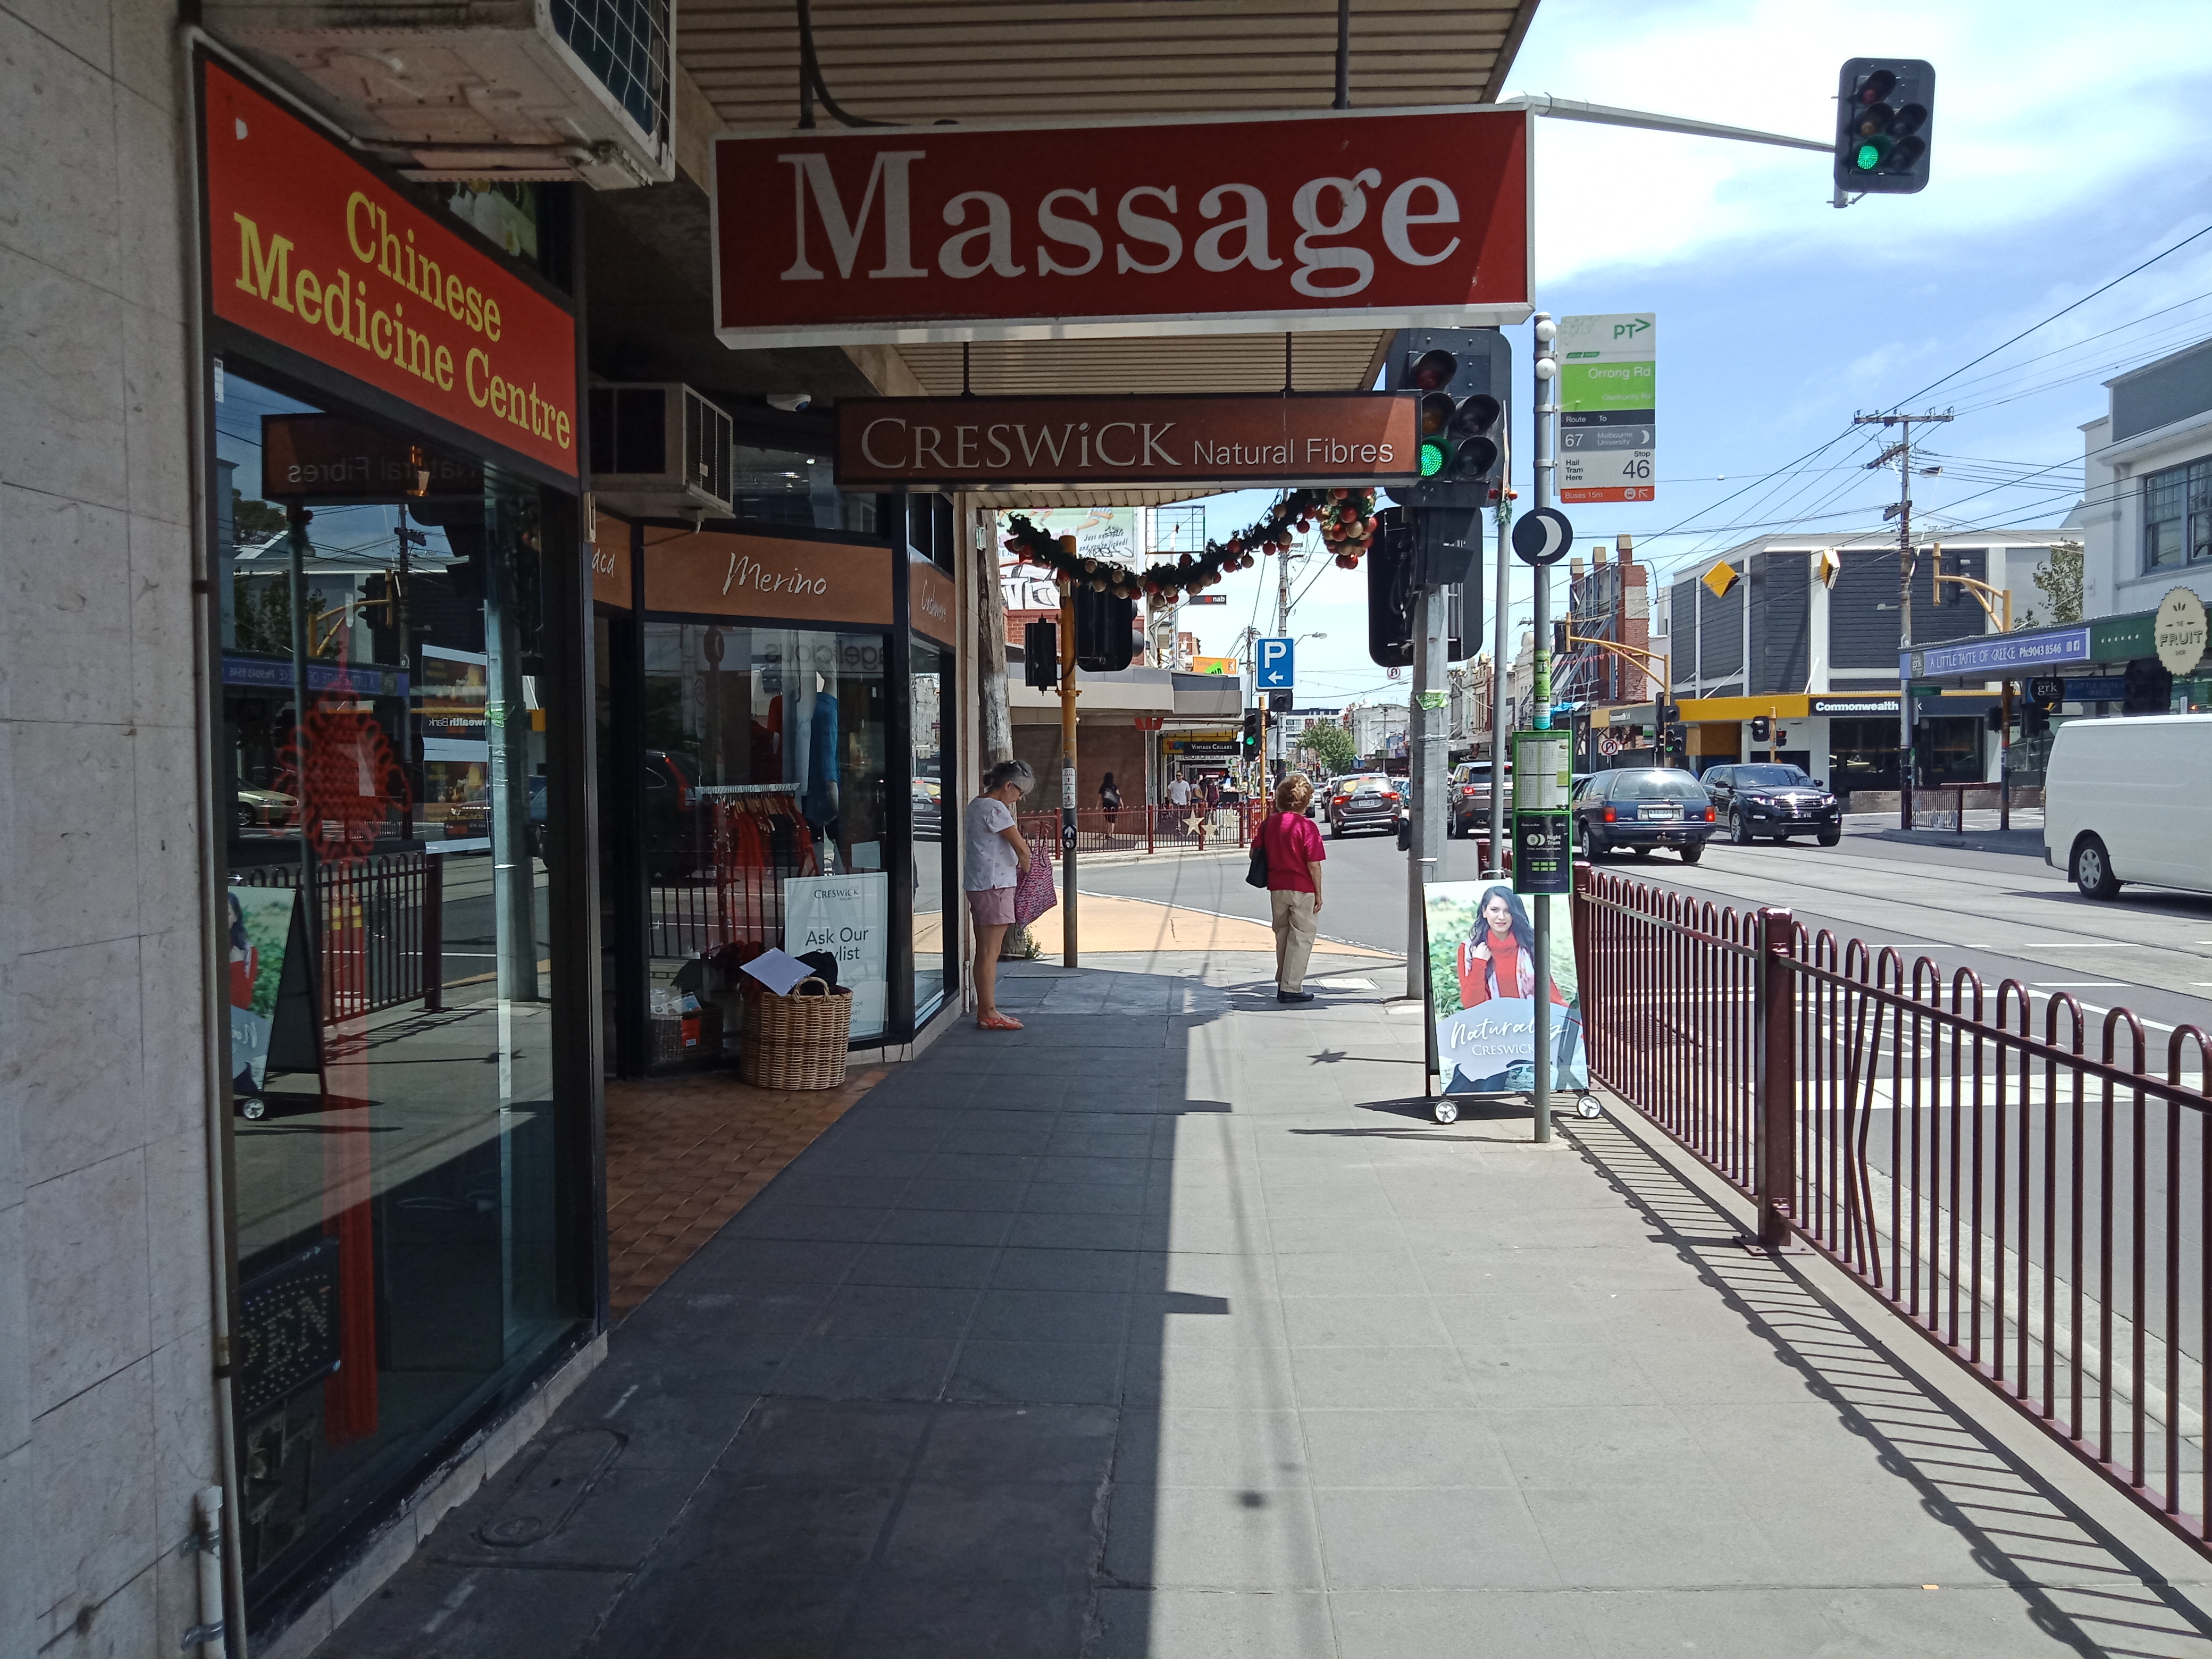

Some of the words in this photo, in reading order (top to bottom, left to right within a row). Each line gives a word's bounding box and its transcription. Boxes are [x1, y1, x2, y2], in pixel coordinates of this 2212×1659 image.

[778, 149, 1460, 297] Massage
[346, 192, 501, 342] Chinese
[234, 212, 453, 391] Medicine
[465, 347, 570, 450] Centre
[1588, 367, 1630, 380] Orrong
[1634, 366, 1650, 377] Rd
[1193, 438, 1292, 466] Natural
[1305, 437, 1394, 465] Fibres
[1565, 433, 1583, 447] 67
[1622, 459, 1650, 479] 46
[591, 547, 615, 579] aca
[723, 552, 828, 597] Merino
[2159, 630, 2203, 647] FRUIT
[1264, 641, 1286, 668] P
[1930, 658, 1934, 668] A
[1958, 651, 1976, 665] TASTE
[1979, 650, 1989, 663] OF
[1991, 647, 2016, 661] GREECE
[2019, 644, 2045, 658] Ph:9043
[2045, 643, 2062, 654] 8546
[2037, 682, 2057, 696] grk
[1815, 701, 1899, 711] Commonwealth
[805, 928, 835, 946] Ask
[840, 926, 869, 943] Our
